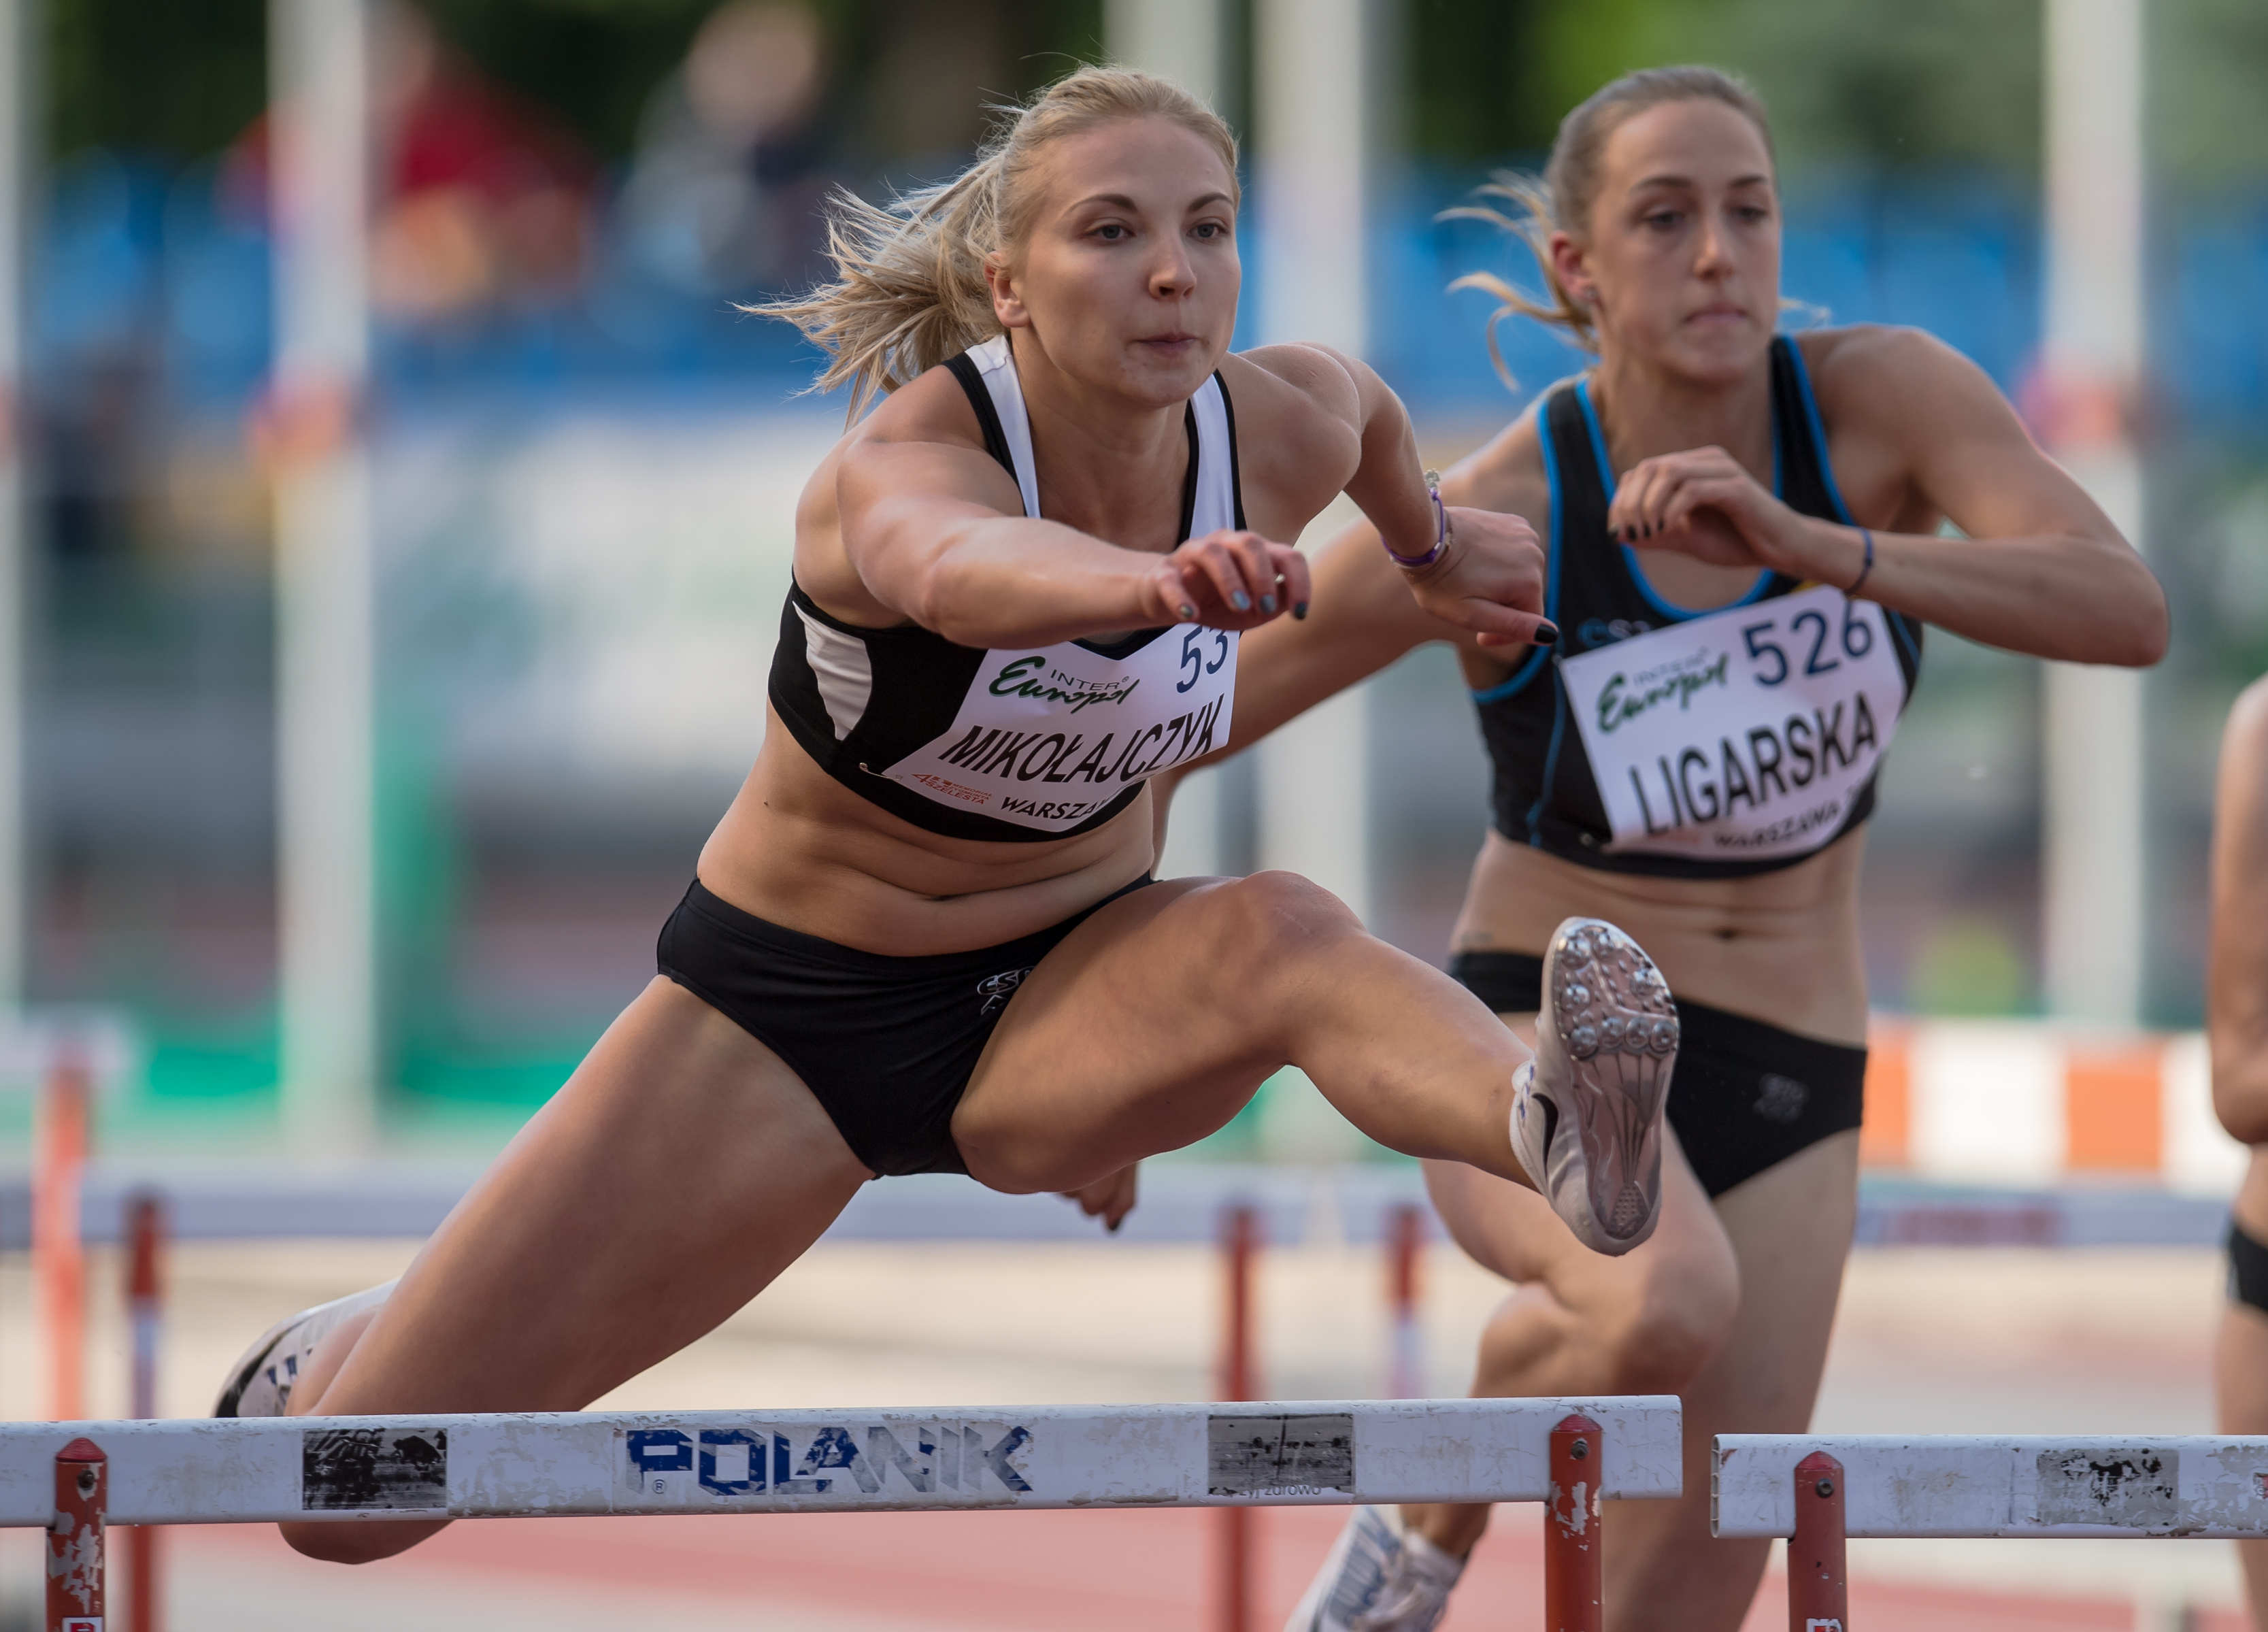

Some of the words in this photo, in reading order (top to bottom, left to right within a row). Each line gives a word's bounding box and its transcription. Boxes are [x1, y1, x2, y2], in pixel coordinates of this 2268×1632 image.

[1742, 601, 1872, 686] 526
[988, 656, 1140, 714] Europol
[1050, 669, 1120, 691] INTER
[937, 693, 1225, 784] MIKOŁAJCZYK
[1627, 690, 1878, 835] LIGARSKA
[926, 782, 984, 804] SZELESTA
[626, 1425, 1034, 1497] POLANIK
